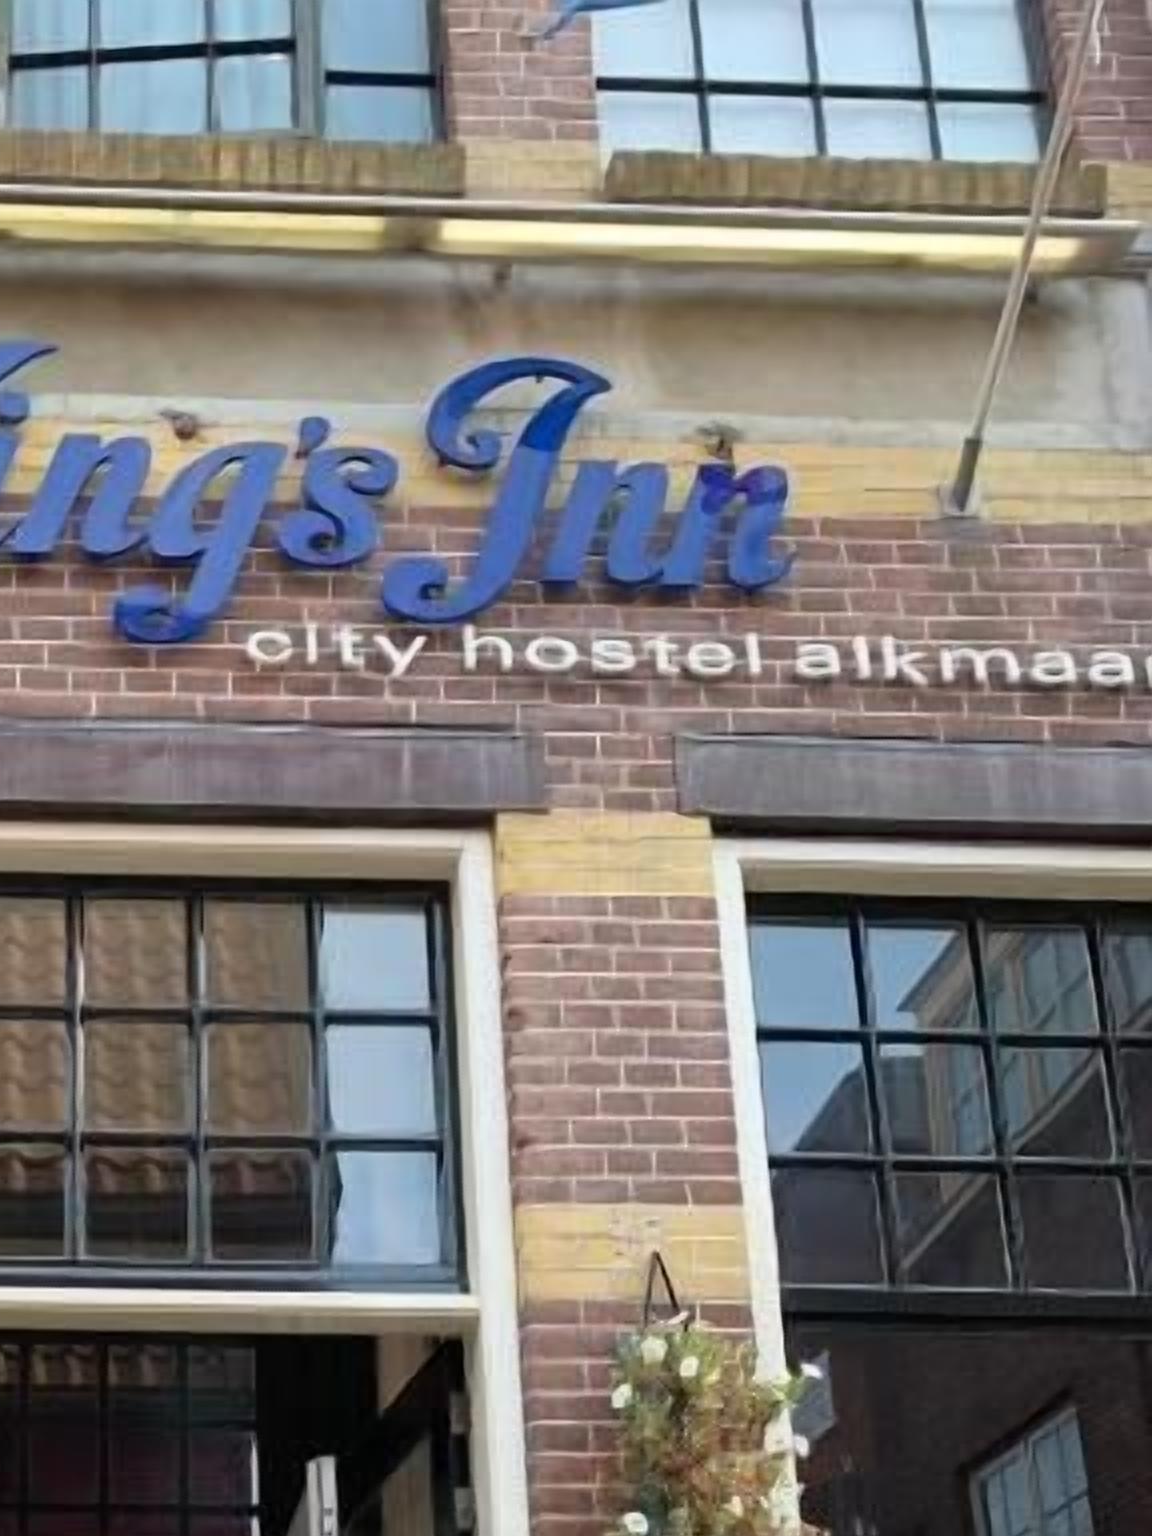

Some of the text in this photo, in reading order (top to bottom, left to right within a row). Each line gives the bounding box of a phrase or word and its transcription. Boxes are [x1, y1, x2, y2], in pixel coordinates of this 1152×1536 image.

[381, 356, 795, 624] Inn
[247, 624, 426, 678] city
[463, 624, 762, 677] hostel
